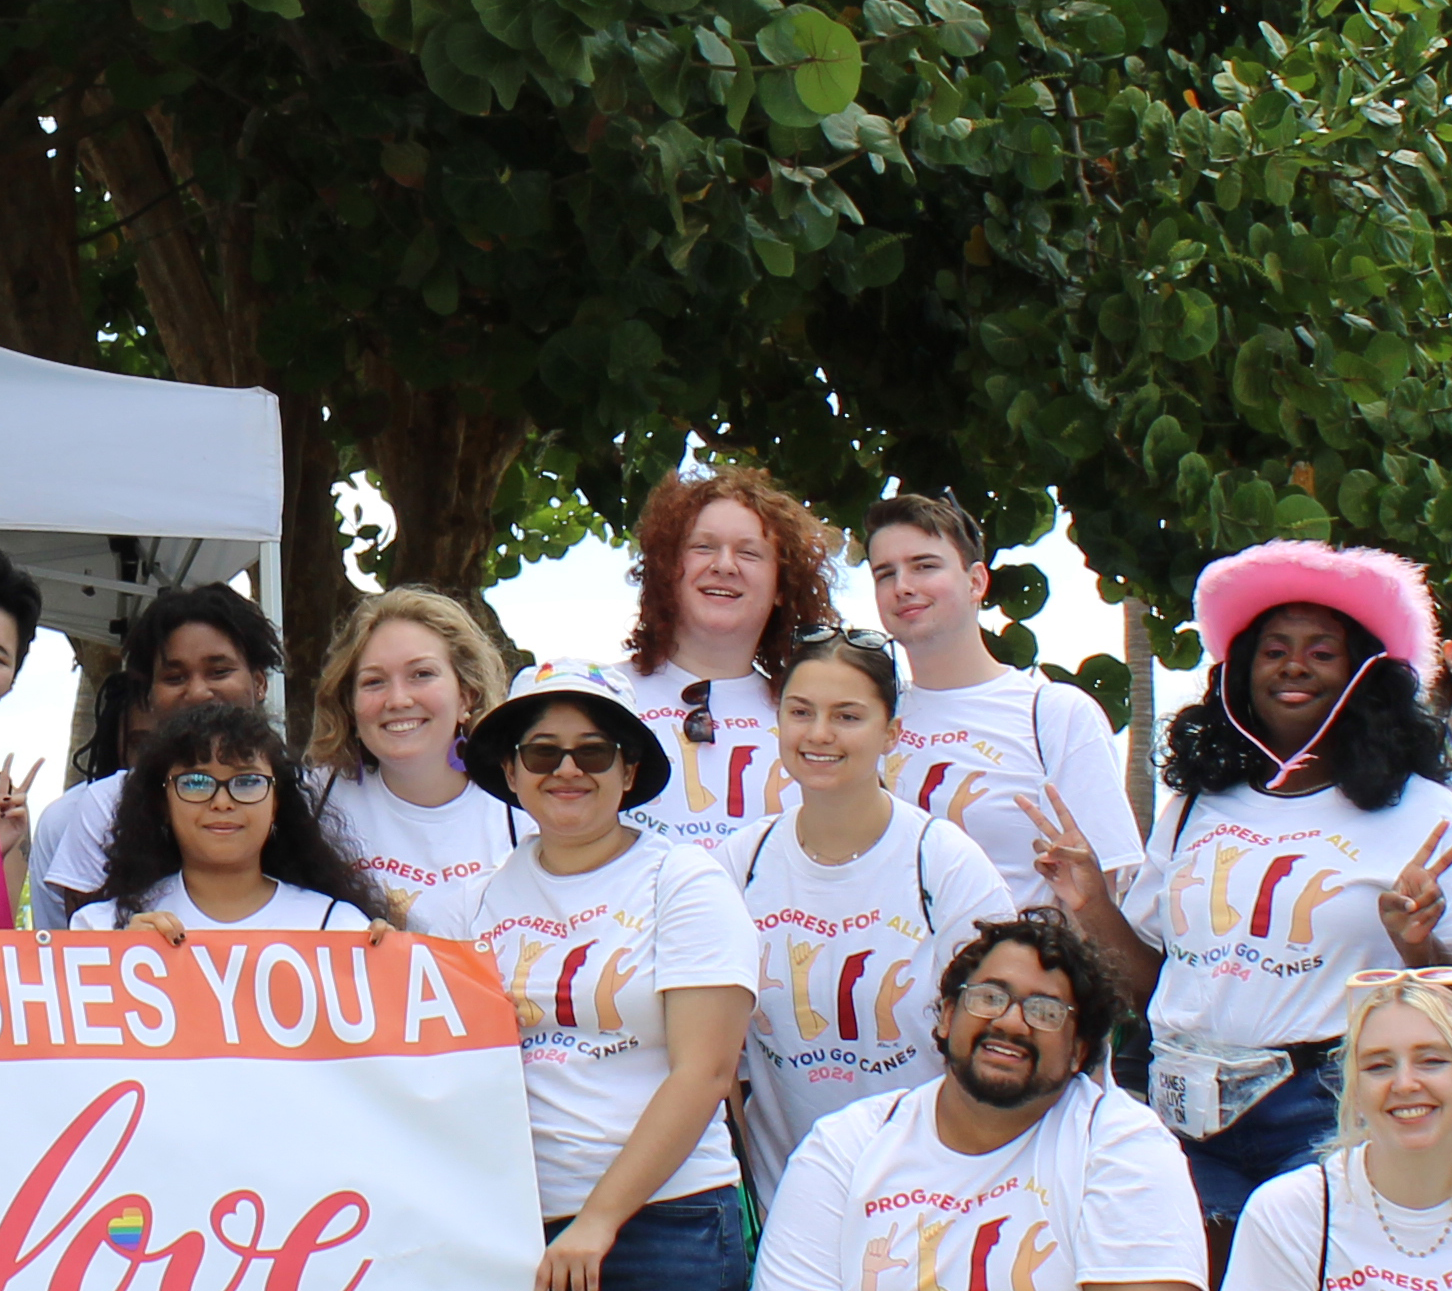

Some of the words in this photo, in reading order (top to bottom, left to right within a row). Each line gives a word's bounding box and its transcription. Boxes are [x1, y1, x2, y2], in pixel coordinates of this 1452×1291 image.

[723, 717, 760, 729] FOR
[930, 730, 969, 746] FOR
[973, 740, 1003, 766] ALL
[624, 809, 669, 835] LOVE
[676, 821, 711, 837] YOU
[1277, 829, 1321, 844] FOR
[1325, 834, 1360, 862] ALL
[441, 861, 482, 881] FOR
[570, 905, 608, 930] FOR
[612, 910, 646, 933] ALL
[843, 910, 881, 932] FOR
[886, 915, 924, 942] ALL
[1201, 943, 1232, 966] YOU
[1234, 943, 1260, 960] GO
[1261, 954, 1324, 977] CANES
[1211, 964, 1252, 982] 2024
[190, 944, 375, 1046] YOU
[404, 944, 467, 1043] A
[523, 1050, 568, 1064] 2024
[552, 1033, 576, 1048] GO
[577, 1036, 640, 1060] CANES
[787, 1048, 826, 1069] YOU
[830, 1048, 856, 1066] GO
[859, 1045, 917, 1075] CANES
[808, 1068, 854, 1084] 2024
[1159, 1072, 1186, 1092] CANES
[864, 1189, 972, 1217] PROGRESS
[977, 1178, 1018, 1207] FOR
